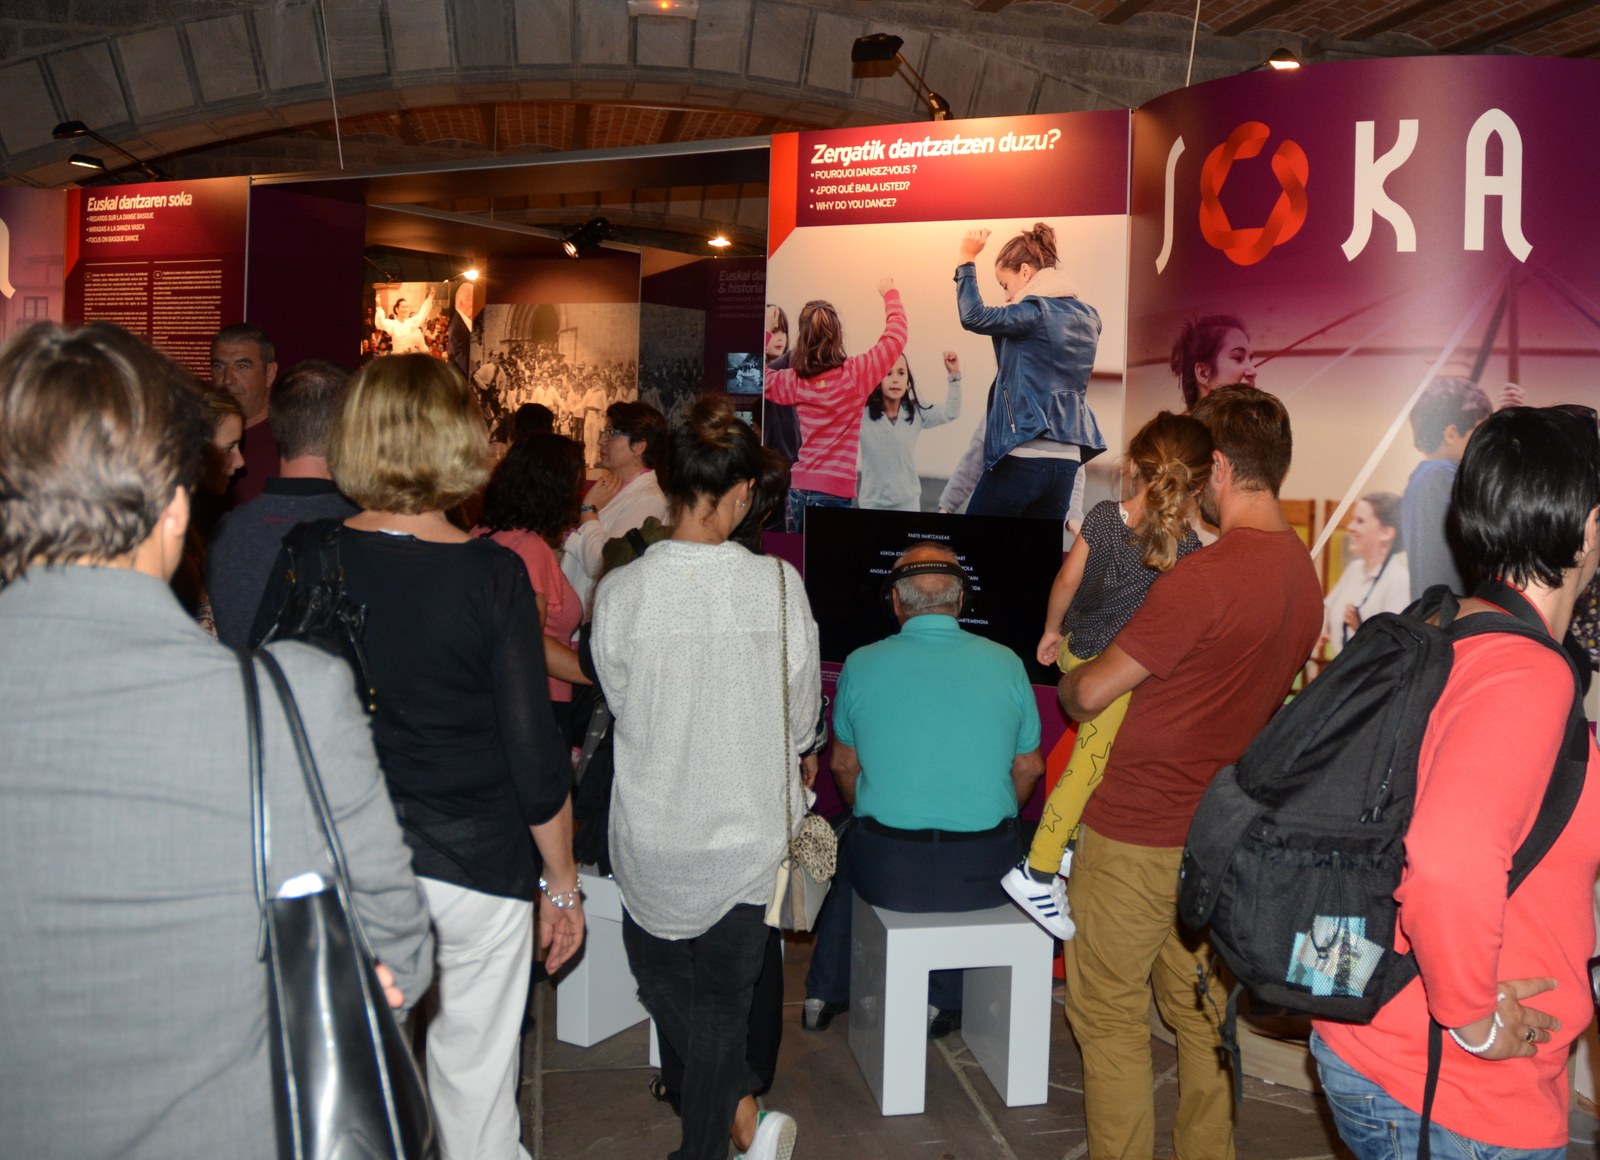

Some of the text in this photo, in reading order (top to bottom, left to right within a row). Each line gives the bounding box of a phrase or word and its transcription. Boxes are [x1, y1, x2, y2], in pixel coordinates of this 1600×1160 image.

[811, 128, 1062, 166] Zergatik dantzatzen duzu?
[815, 168, 856, 180] POURQUOI
[856, 165, 910, 177] DANSEZ-VOUS
[816, 181, 910, 195] ¿POR QUÉ BAILA USTED?
[87, 190, 193, 212] Euskal dantzaren soka
[816, 198, 897, 211] WHY DO YOU DANCE?
[131, 223, 145, 231] VASCA
[125, 234, 139, 242] DANCE
[719, 270, 751, 281] Euskal
[728, 282, 764, 293] historia
